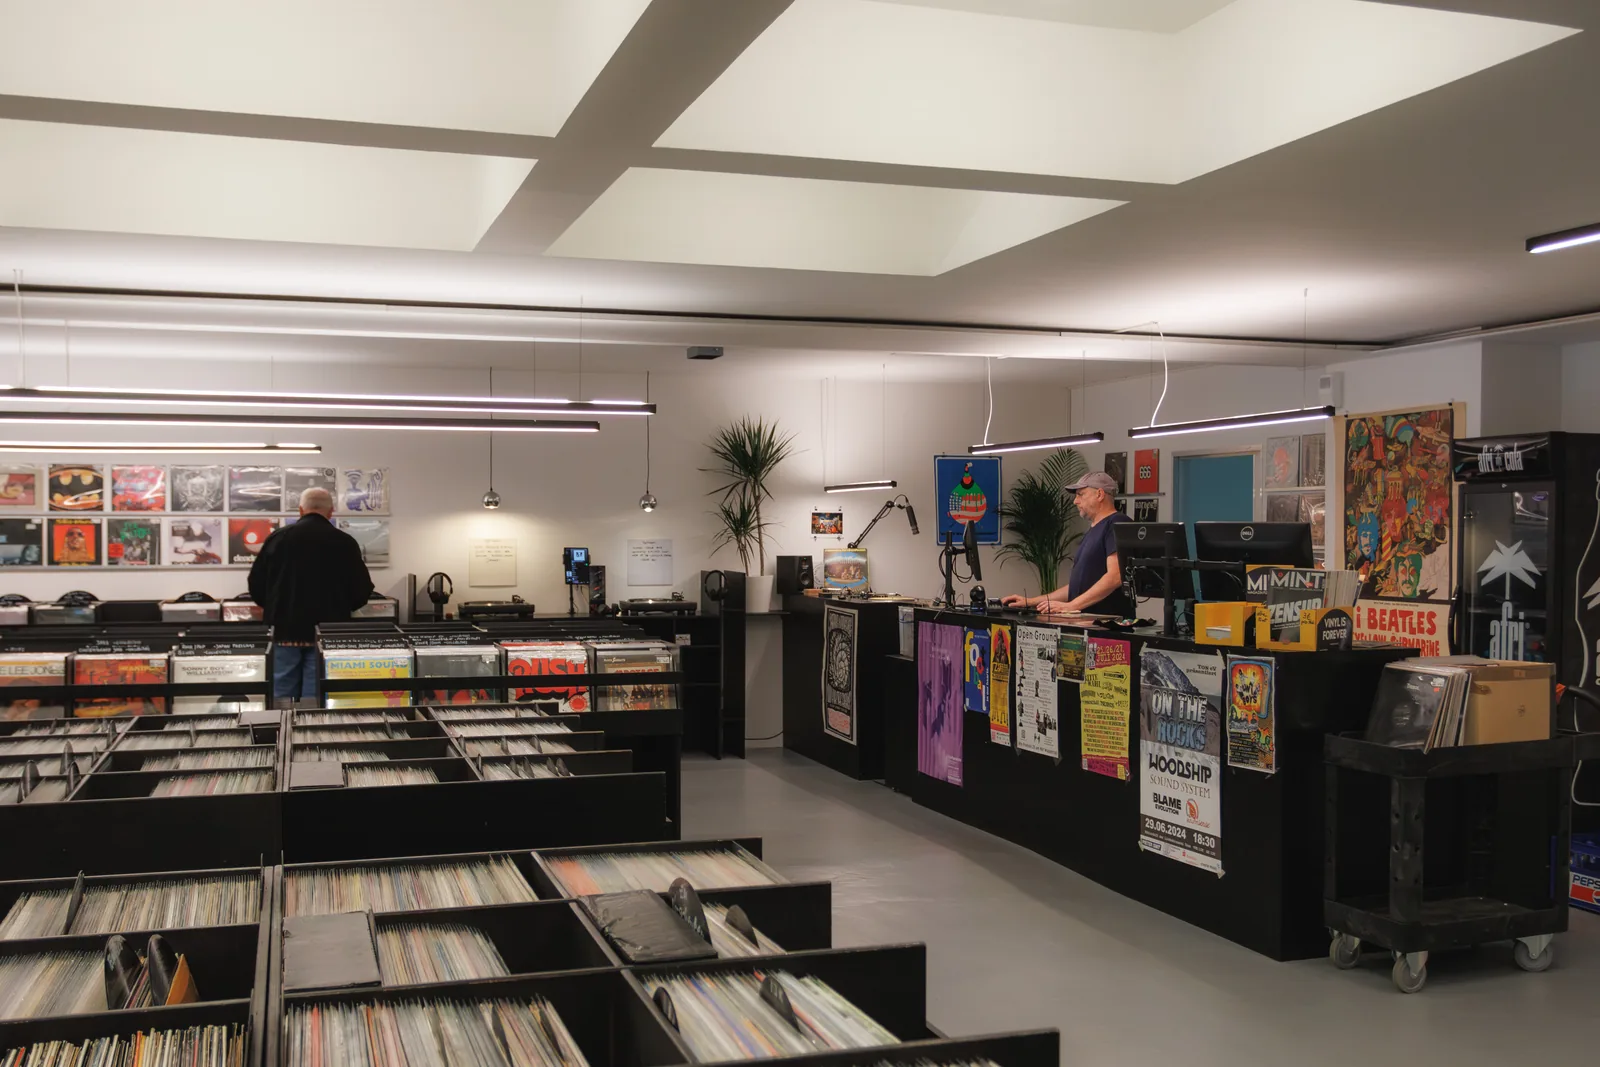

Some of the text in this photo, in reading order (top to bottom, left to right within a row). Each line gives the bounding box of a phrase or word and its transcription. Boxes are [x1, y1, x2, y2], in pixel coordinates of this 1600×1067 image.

[1478, 442, 1523, 472] afri cola
[1140, 466, 1151, 479] 666
[1246, 574, 1270, 591] MI
[1270, 570, 1325, 589] MINT
[1324, 618, 1340, 628] VINYL
[1340, 617, 1346, 626] IS
[1368, 608, 1437, 636] BEATLES
[1489, 601, 1524, 660] afri
[1018, 628, 1057, 642] Open Ground
[1322, 629, 1347, 640] FOREVER
[1112, 653, 1126, 661] 2024
[9, 666, 29, 676] LEE
[1152, 689, 1172, 716] ON
[1178, 692, 1208, 724] THE
[1158, 718, 1206, 751] ROCKS
[1148, 753, 1212, 784] WOODSHIP
[1150, 774, 1211, 798] SOUND SYSTEM
[1153, 792, 1182, 810] BLAME
[1155, 804, 1179, 816] EVOLUTION
[1145, 818, 1186, 840] 29.06.2024
[1193, 832, 1216, 848] 18:30
